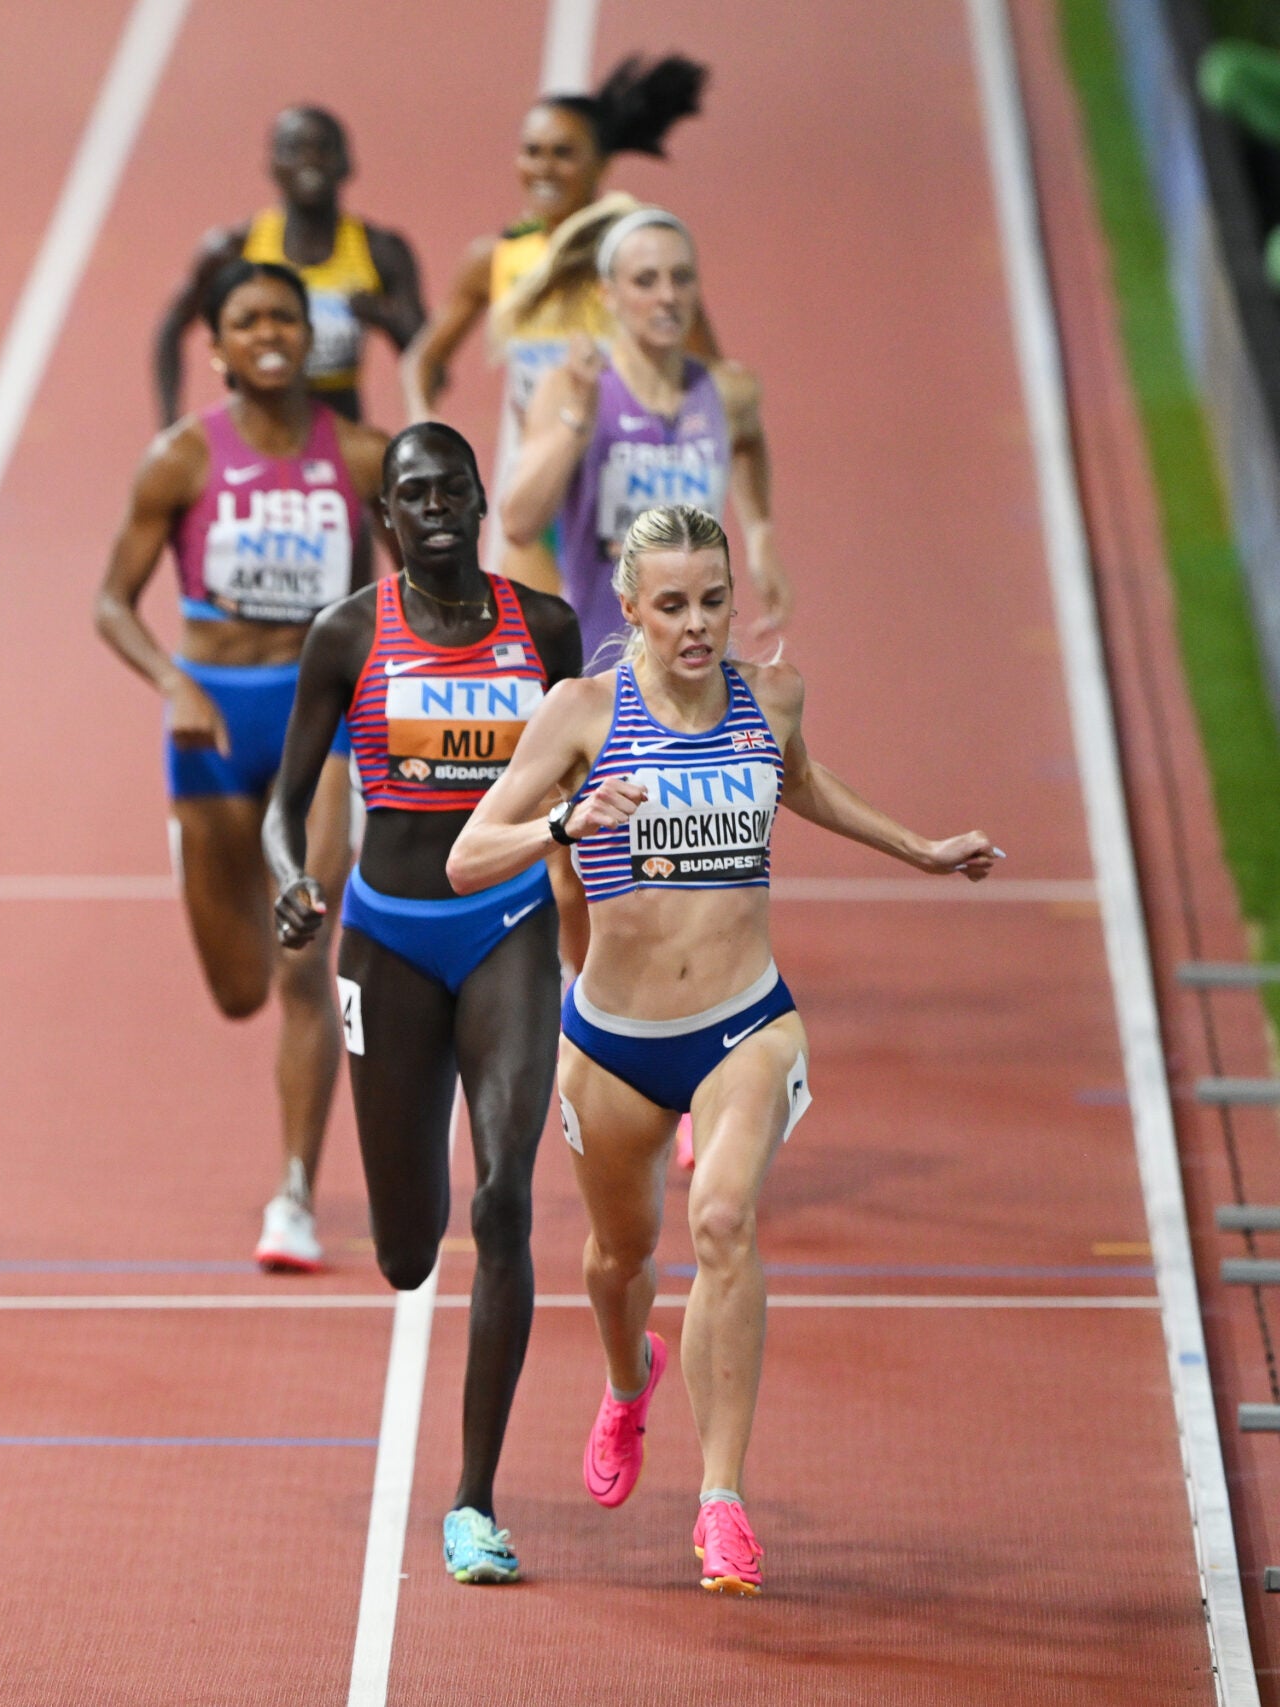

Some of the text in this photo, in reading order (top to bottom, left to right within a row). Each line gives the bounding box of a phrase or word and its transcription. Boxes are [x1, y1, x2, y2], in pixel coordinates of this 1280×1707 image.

[626, 468, 708, 496] NTN
[217, 488, 348, 531] USA
[236, 532, 324, 562] NTN
[421, 681, 518, 716] NTN
[442, 730, 495, 758] MU
[434, 765, 508, 780] BUDAPES
[658, 767, 755, 810] NTN
[637, 809, 770, 851] HODGKINSON
